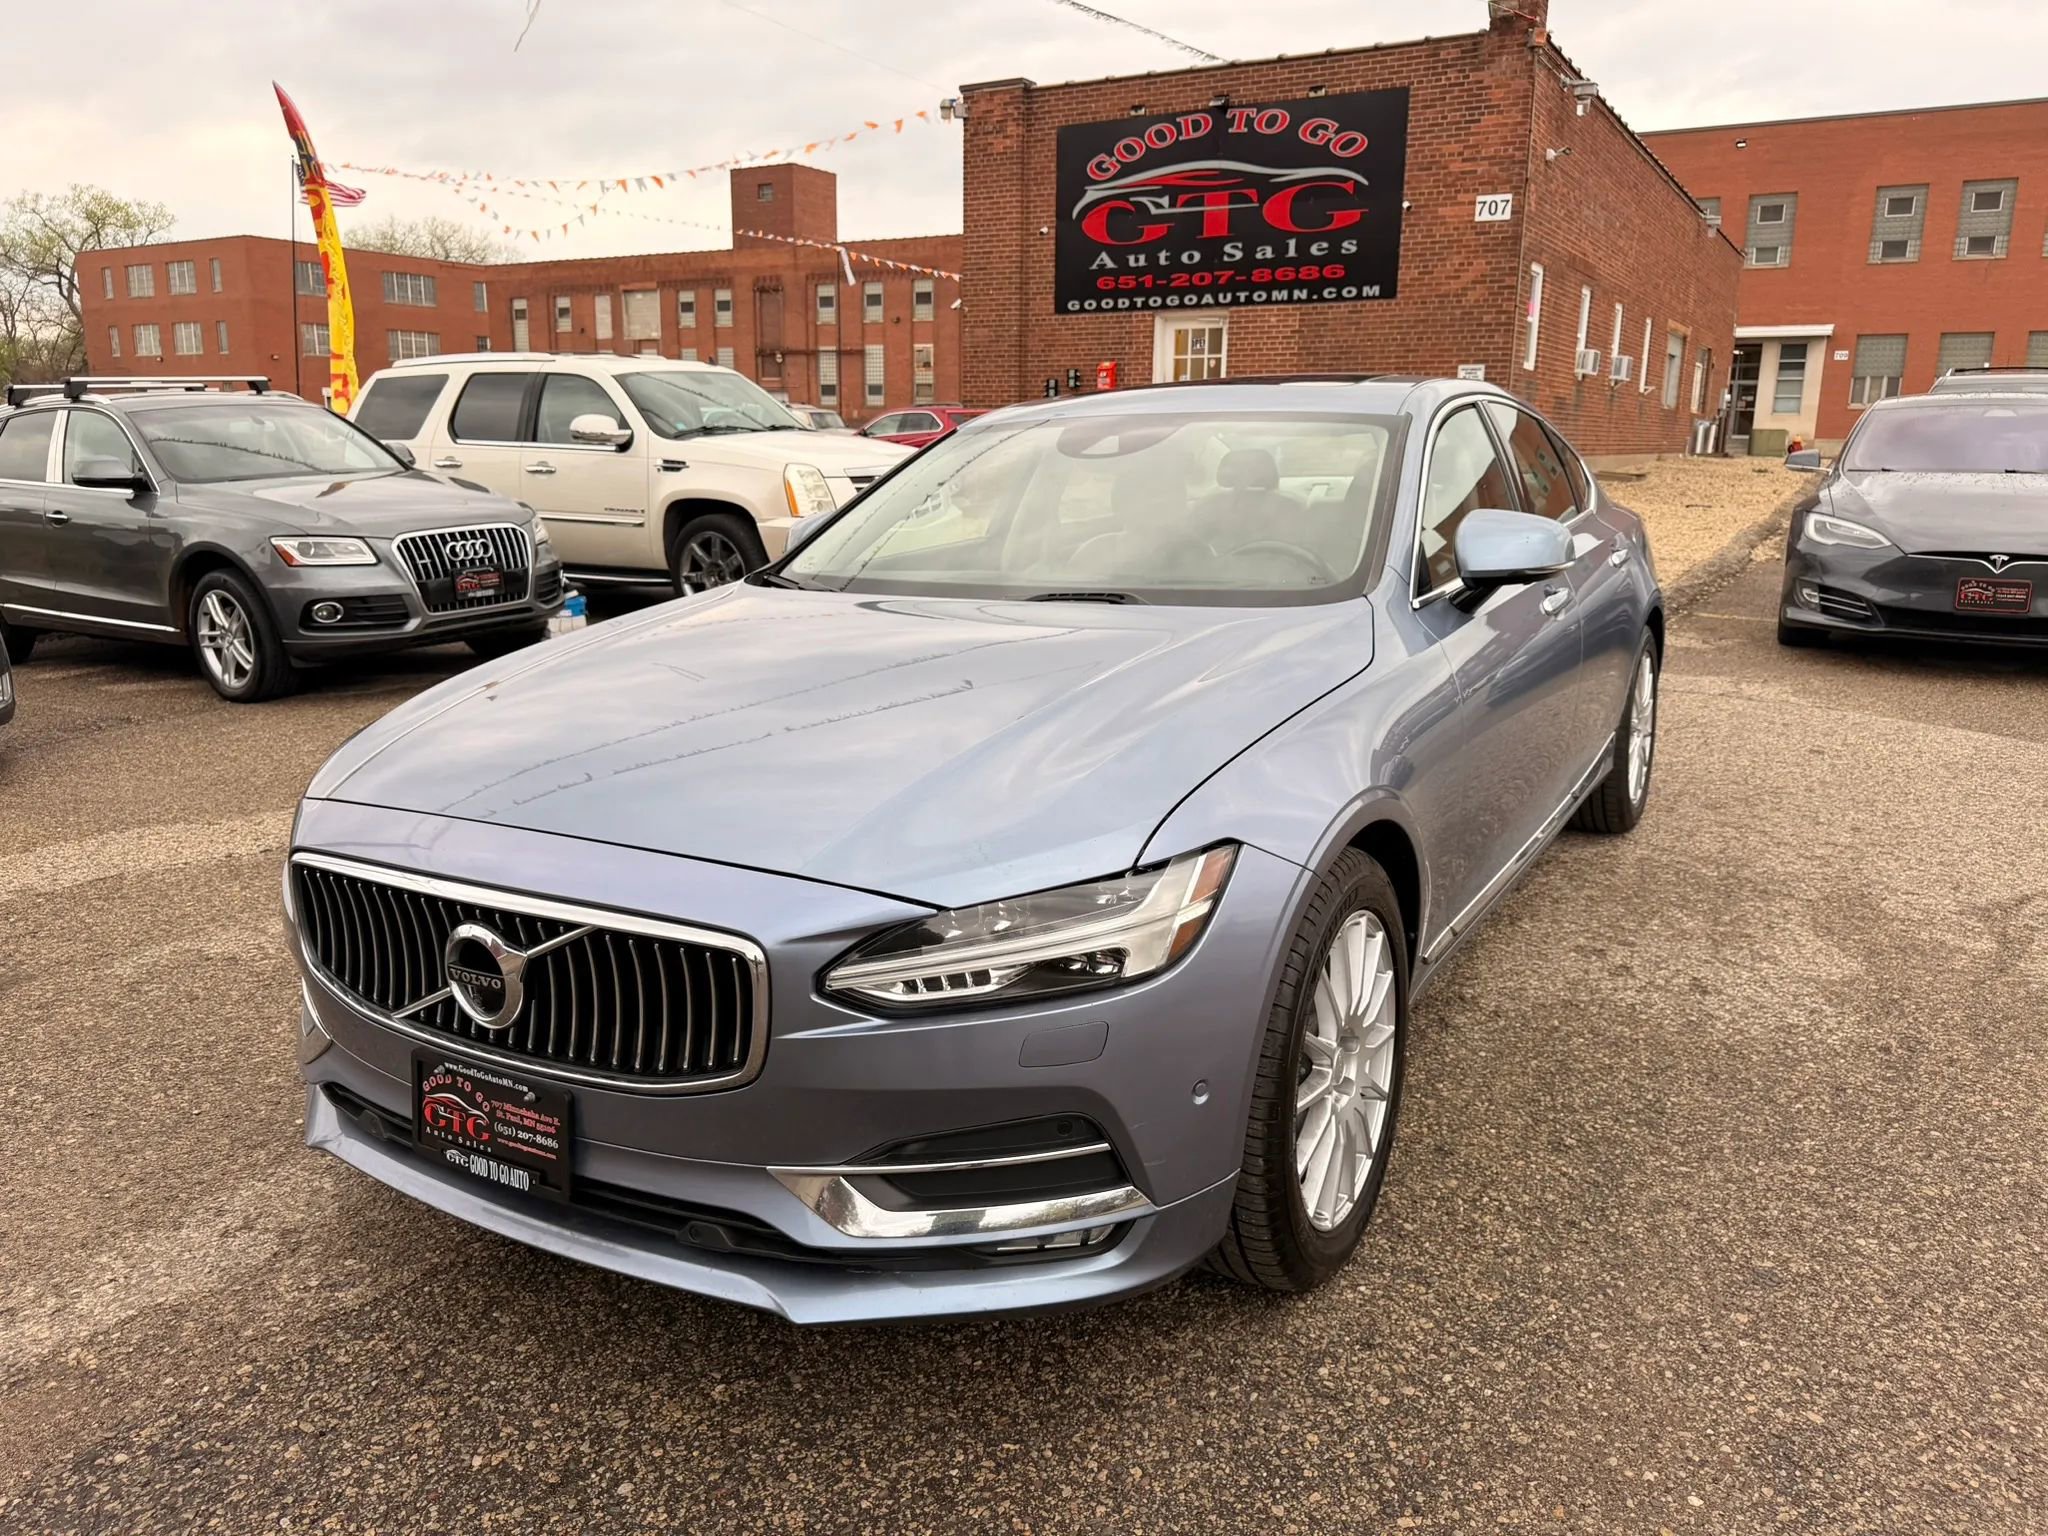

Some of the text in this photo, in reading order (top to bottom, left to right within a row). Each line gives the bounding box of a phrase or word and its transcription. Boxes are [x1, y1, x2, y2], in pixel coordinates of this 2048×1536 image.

[1087, 108, 1368, 180] GOOD TO GO
[1081, 180, 1369, 245] GTG
[1477, 199, 1511, 217] 707
[1089, 238, 1358, 270] Auto Sales
[1096, 264, 1345, 290] 651-207-8686
[1067, 285, 1380, 311] GOODTOGOAUTOMN.COM
[449, 968, 502, 989] VOLVO
[422, 1074, 490, 1112] GOOD TO GO
[424, 1103, 491, 1140] GTG
[494, 1121, 516, 1137] (651)
[517, 1130, 559, 1149] 207-8686
[425, 1126, 453, 1140] Auto
[458, 1136, 492, 1153] Sales
[470, 1154, 488, 1177] GOOD
[489, 1160, 499, 1181] TO
[500, 1164, 510, 1185] GO
[510, 1167, 529, 1191] AUTO
